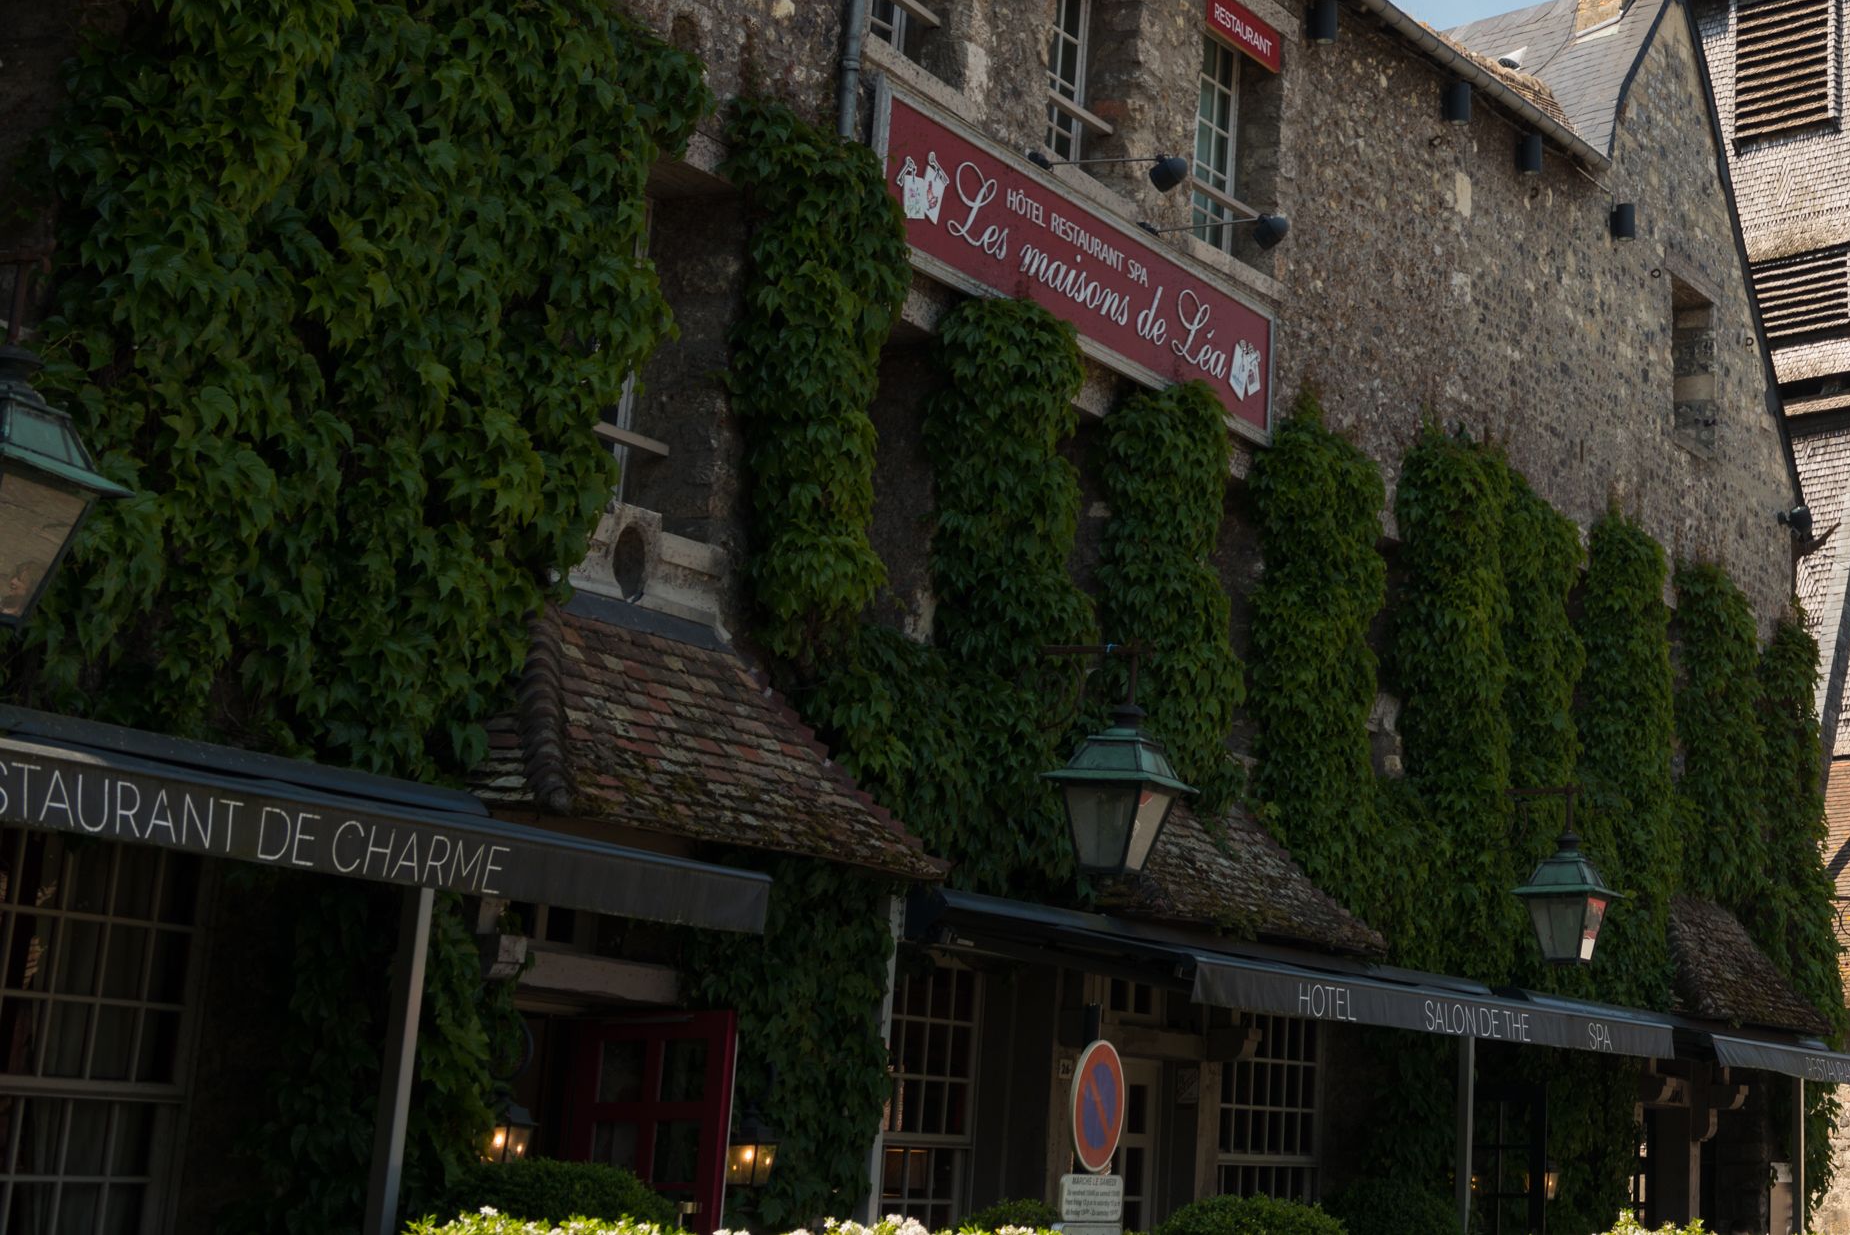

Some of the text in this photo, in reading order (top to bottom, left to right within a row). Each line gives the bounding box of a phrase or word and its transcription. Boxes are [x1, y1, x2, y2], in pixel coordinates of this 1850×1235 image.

[1214, 3, 1272, 57] RESTAURANT
[947, 162, 1226, 379] Les maisons de Léa
[1006, 189, 1148, 287] HÔTEL RESTAURANT SPA
[257, 807, 321, 866] DE
[332, 820, 511, 895] CHARME
[1298, 982, 1613, 1051] HOTEL SALON DE THE SPA
